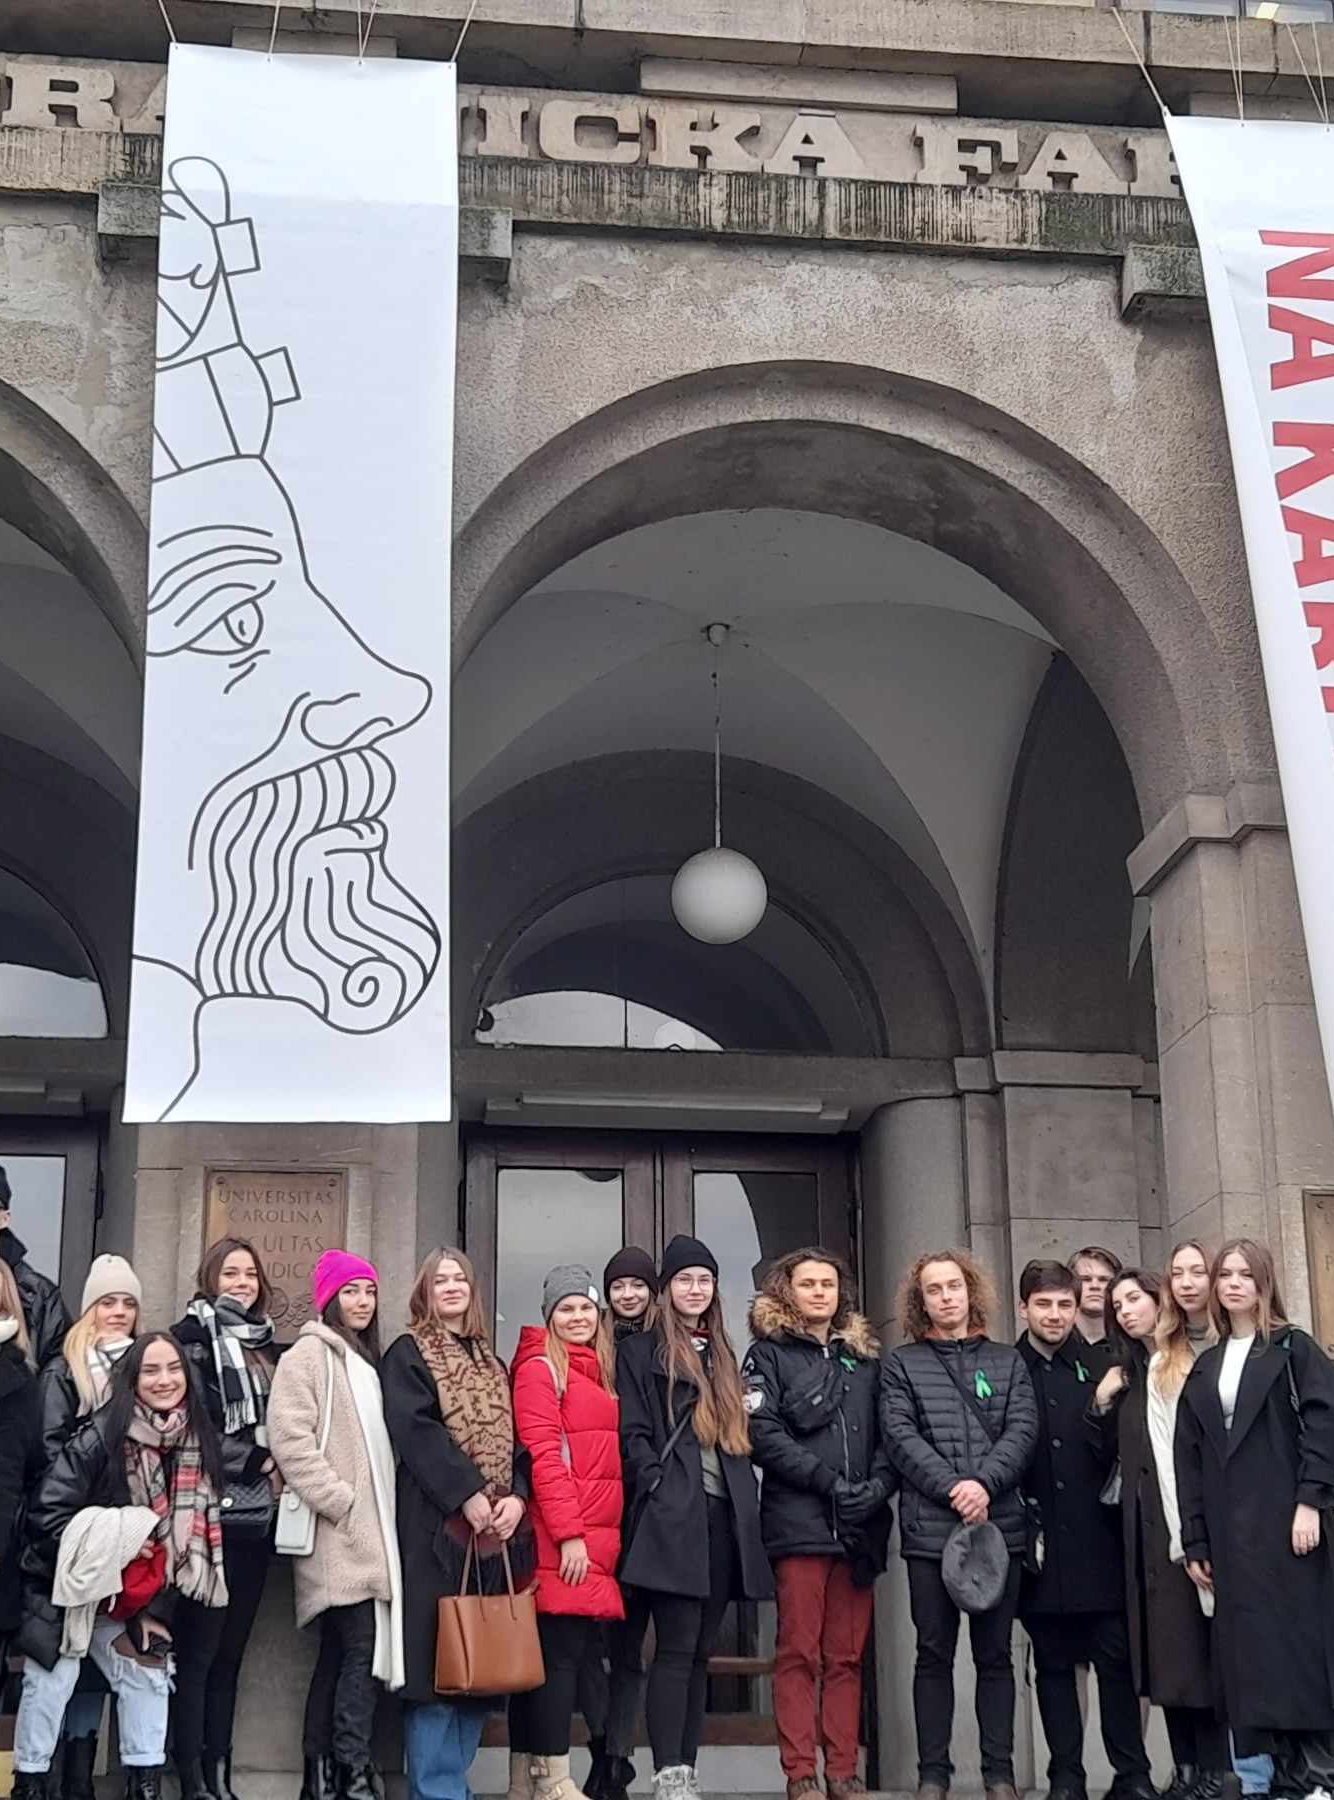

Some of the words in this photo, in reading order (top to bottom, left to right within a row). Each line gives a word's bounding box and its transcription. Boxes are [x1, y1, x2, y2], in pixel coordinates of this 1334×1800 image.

[218, 1189, 334, 1205] UNIVERSITAS
[228, 1209, 324, 1225] CAROLINA
[247, 1234, 325, 1253] CULTAS
